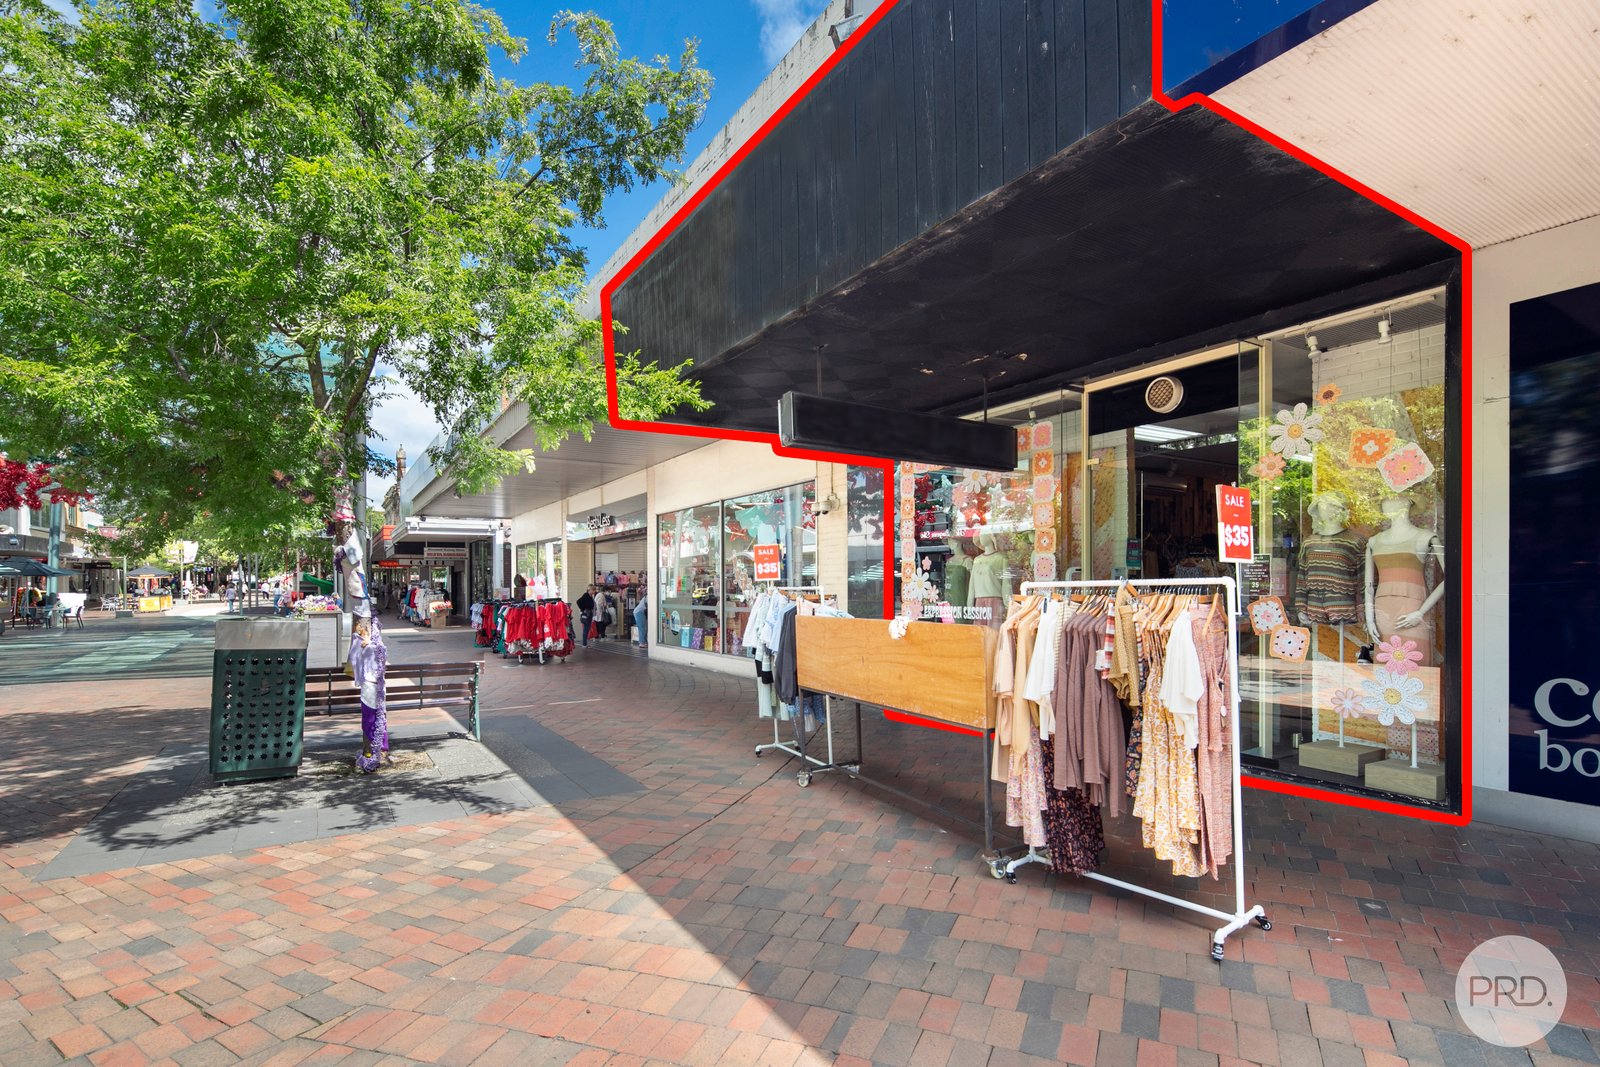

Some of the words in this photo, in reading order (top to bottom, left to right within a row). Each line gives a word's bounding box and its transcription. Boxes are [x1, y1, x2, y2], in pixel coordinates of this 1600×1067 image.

[1225, 494, 1244, 508] SALE
[1225, 524, 1249, 547] $35
[757, 563, 777, 575] $35
[1251, 581, 1259, 589] 35
[963, 606, 992, 620] SESSION
[1534, 678, 1600, 727] C
[1534, 729, 1600, 777] bo
